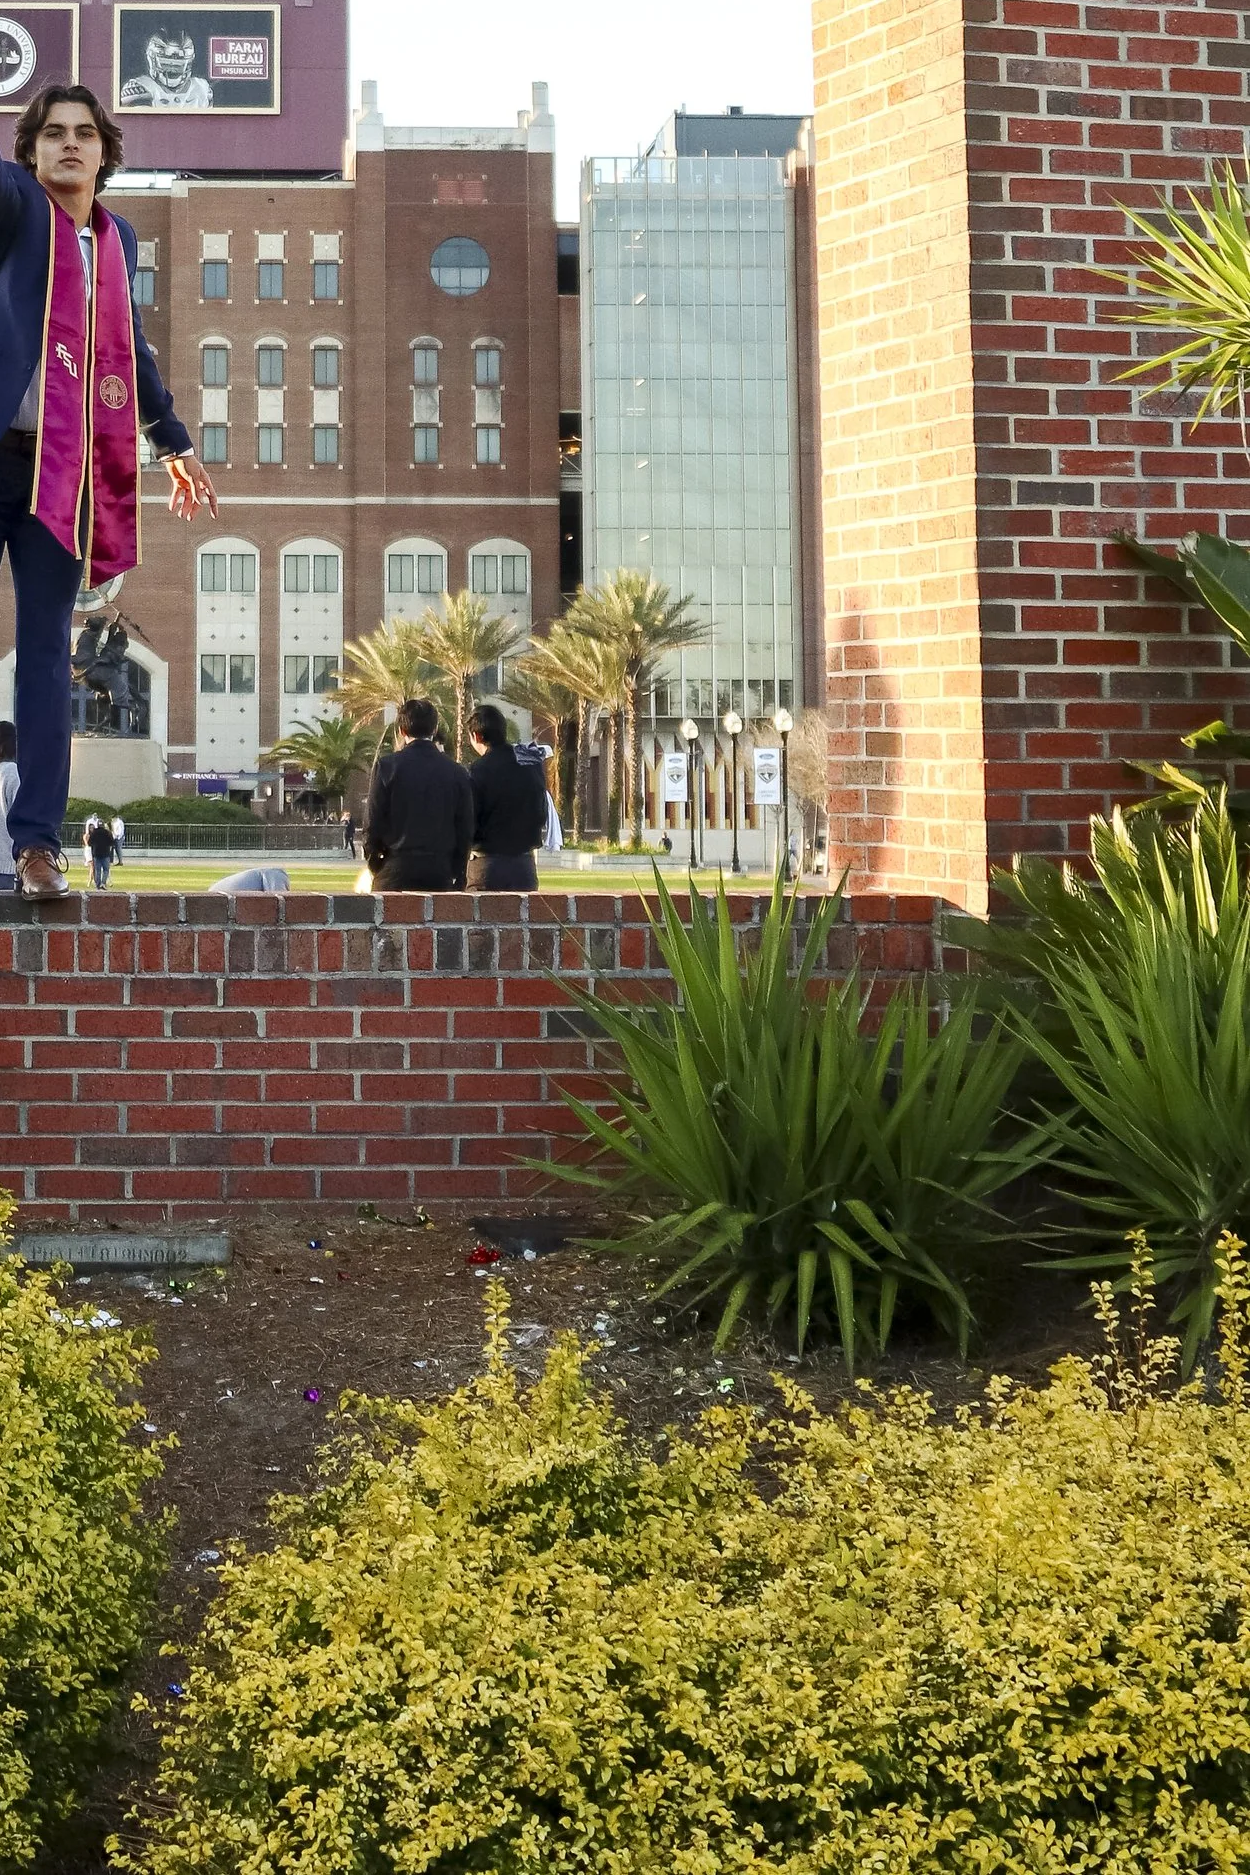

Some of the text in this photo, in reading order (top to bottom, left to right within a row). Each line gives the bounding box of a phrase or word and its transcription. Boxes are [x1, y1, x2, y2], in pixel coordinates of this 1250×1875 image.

[7, 23, 31, 76] UNIVERSITY
[229, 42, 263, 53] FARM
[214, 53, 264, 64] BUREAU
[221, 67, 264, 75] INSURANCE
[55, 341, 79, 380] FSU
